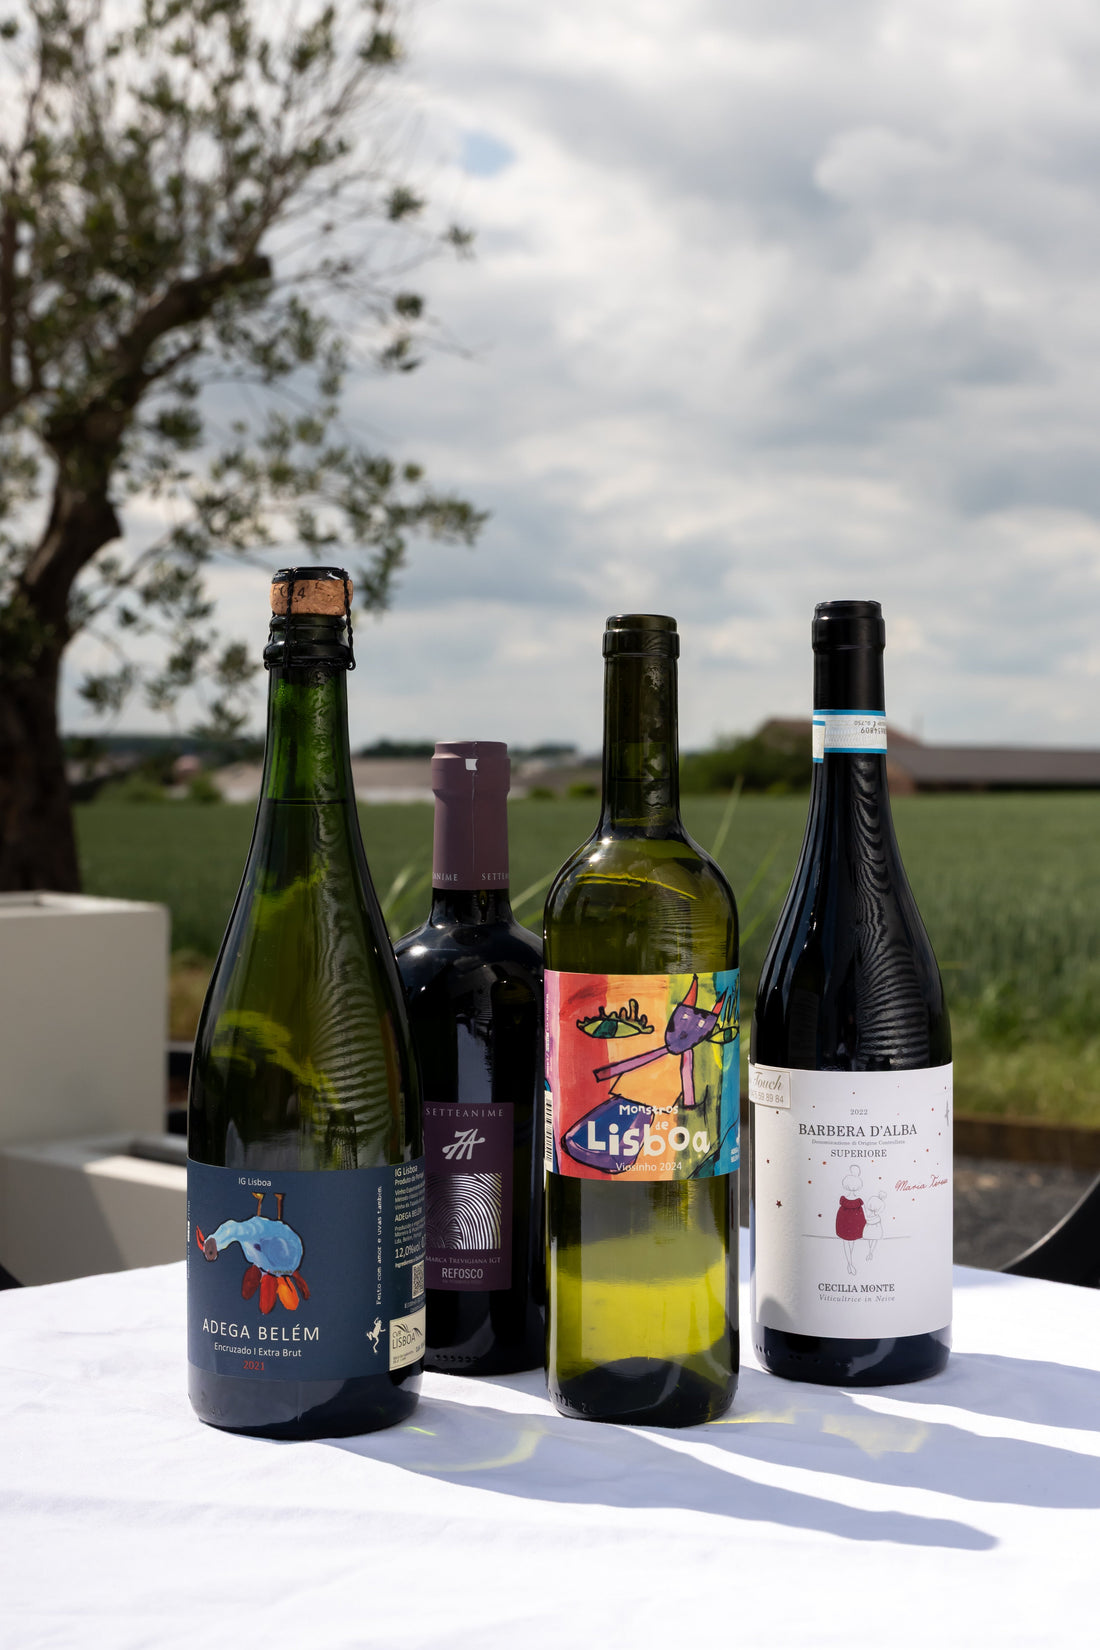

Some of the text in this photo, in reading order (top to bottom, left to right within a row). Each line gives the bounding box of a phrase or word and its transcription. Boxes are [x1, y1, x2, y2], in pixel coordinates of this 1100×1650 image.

[425, 1107, 504, 1118] SETTEANIME
[619, 1104, 679, 1116] Monstros
[655, 1121, 669, 1131] de
[798, 1123, 918, 1138] BARBERA D'ALBA
[830, 1149, 888, 1158] SUPERIORE
[659, 1161, 682, 1172] 2024
[238, 1177, 272, 1187] IG Lisboa
[441, 1267, 484, 1279] REFOSCO
[818, 1283, 895, 1293] CECILIA MONTE
[202, 1318, 320, 1342] ADEGA BELÉM
[392, 1332, 416, 1350] LISBOA
[214, 1342, 252, 1355] Encruzado
[258, 1347, 280, 1357] Extra
[282, 1348, 303, 1358] Brut
[243, 1360, 265, 1371] 2021
